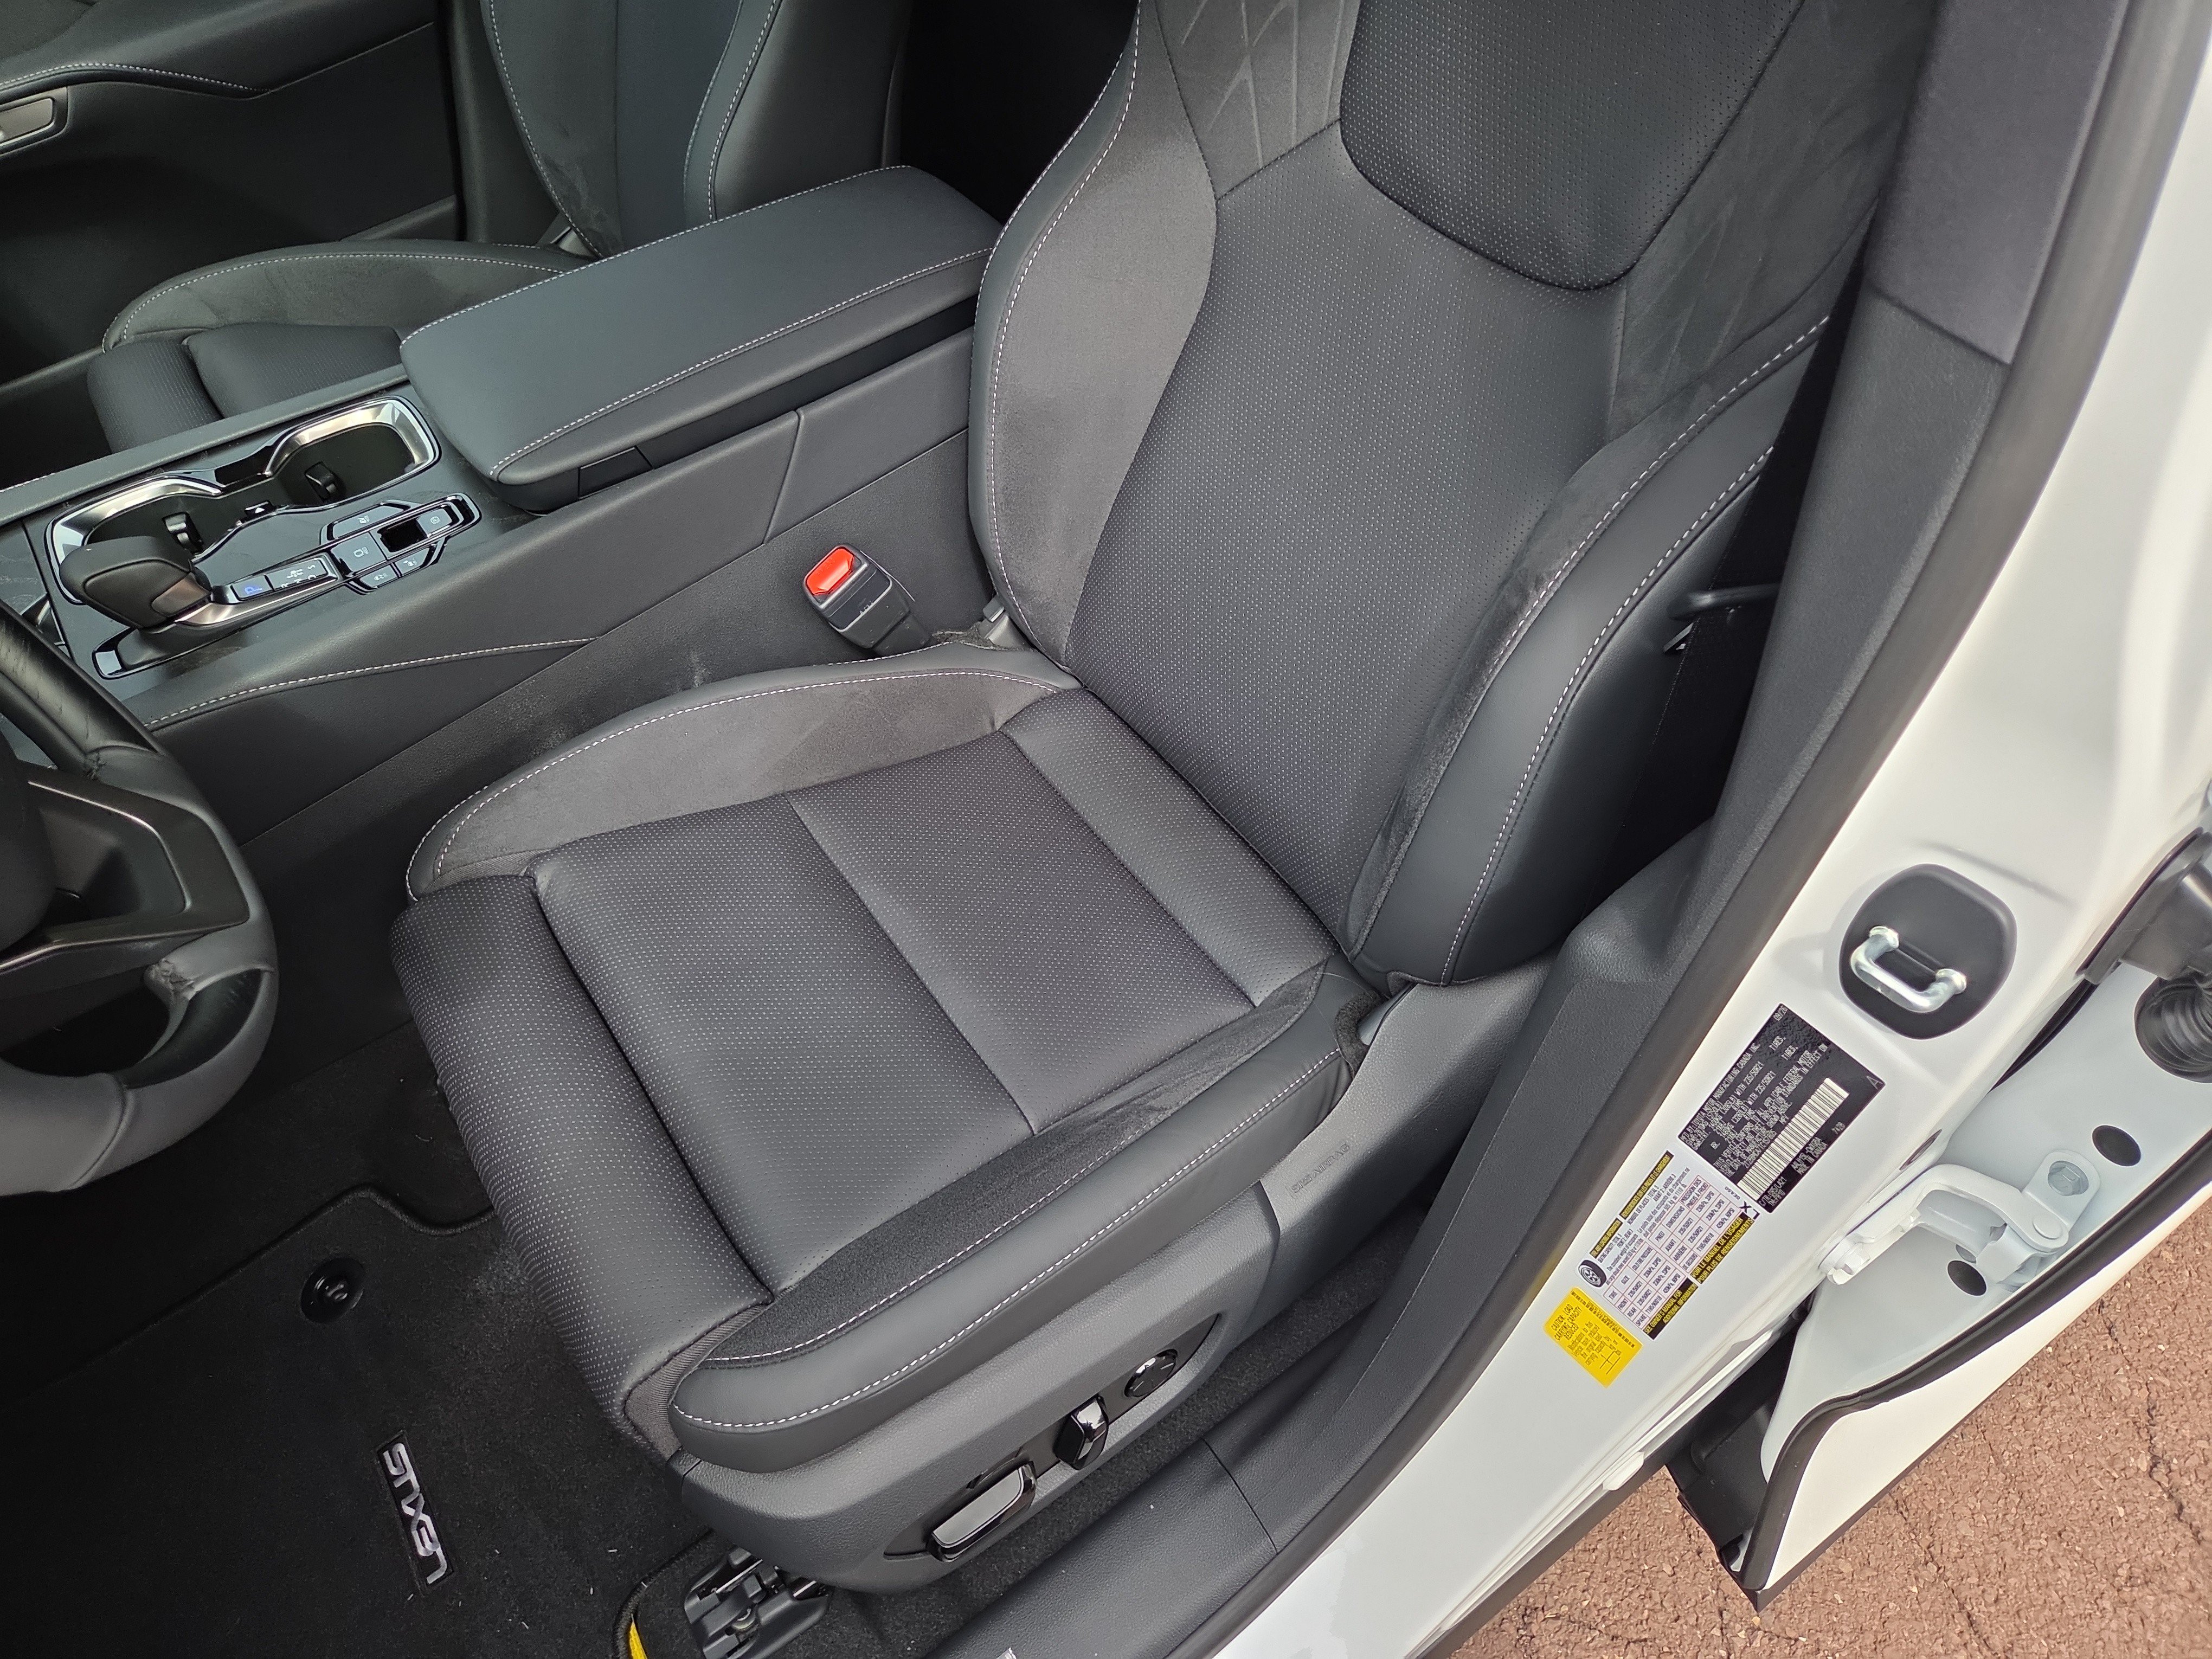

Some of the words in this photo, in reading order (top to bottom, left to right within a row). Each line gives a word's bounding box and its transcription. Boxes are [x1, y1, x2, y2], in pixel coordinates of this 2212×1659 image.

[1773, 1005, 1789, 1021] 09/26
[1734, 1082, 1747, 1096] WITH
[1742, 1060, 1764, 1085] 235/50R21
[1769, 1033, 1786, 1051] TIRES.
[1702, 1097, 1716, 1113] MOTOR
[1712, 1066, 1740, 1100] MANUFACTURING
[1735, 1050, 1753, 1069] CANADA
[1745, 1091, 1758, 1105] WITH
[1754, 1070, 1776, 1095] 235/50R21
[1863, 1072, 1883, 1090] A
[1713, 1156, 1725, 1169] THIS
[1721, 1140, 1738, 1159] VEHICLE
[1734, 1121, 1754, 1142] CONFORMS
[1751, 1114, 1759, 1122] TO
[1755, 1106, 1766, 1117] ALL
[1762, 1081, 1786, 1108] APPLICABLE
[1782, 1064, 1801, 1084] FEDERAL
[1796, 1050, 1812, 1066] MOTOR
[1718, 1155, 1735, 1174] VEHICLE
[1732, 1140, 1748, 1158] SAFETY
[1744, 1131, 1754, 1142] AND
[1751, 1119, 1765, 1134] THEFT
[1761, 1095, 1785, 1122] PREVENTION
[1780, 1072, 1803, 1097] STANDARDS
[1799, 1065, 1809, 1075] IN
[1804, 1050, 1822, 1069] EFFECT
[1817, 1042, 1828, 1053] ON
[1778, 1113, 1790, 1125] MPV
[1724, 1167, 1735, 1178] THE
[1731, 1158, 1743, 1171] DATE
[1739, 1152, 1748, 1160] OF
[1744, 1126, 1769, 1154] MANUFACTURE
[1765, 1113, 1780, 1128] SHOWN
[1291, 1175, 1313, 1193] SRS
[1312, 1143, 1350, 1179] AIRBAG
[1795, 1161, 1810, 1175] MADE
[1810, 1140, 1829, 1159] CANADA
[1680, 1185, 1696, 1204] PRESSION
[1693, 1178, 1702, 1187] DES
[1686, 1195, 1698, 1208] PNEUS
[1697, 1181, 1709, 1194] FROID
[1666, 1205, 1685, 1228] DIMENSIONS
[1739, 1200, 1760, 1220] LX
[1654, 1230, 1665, 1242] PNEU
[1722, 1216, 1744, 1239] L'USAGER
[1664, 1238, 1676, 1251] AVANT
[1696, 1270, 1709, 1283] POUR
[1706, 1259, 1718, 1272] PLUS
[1714, 1253, 1724, 1261] DE
[1720, 1217, 1754, 1255] RENSEIGNEMENTS
[1718, 1237, 1727, 1245] DE
[1671, 1244, 1687, 1262] ARRIÈRE
[1703, 1243, 1721, 1263] MANUEL
[1620, 1275, 1630, 1284] SIZE
[1690, 1266, 1702, 1278] VOIR
[1608, 1290, 1617, 1300] TIRE
[1617, 1298, 1629, 1310] FRONT
[1662, 1303, 1680, 1323] ADDITIONAL
[1676, 1283, 1697, 1306] INFORMATION
[1562, 1303, 1574, 1316] LOAD
[1626, 1307, 1637, 1317] REAR
[1635, 1314, 1647, 1326] SPARE
[1644, 1325, 1652, 1334] SEE
[1649, 1310, 1665, 1328] OWNER'S
[1662, 1296, 1676, 1313] MANUAL
[1673, 1289, 1683, 1299] FOR
[1553, 1321, 1571, 1341] CARRYING
[1565, 1305, 1583, 1324] CAPACITY
[1563, 1322, 1579, 1340] REDUCED
[383, 1443, 447, 1584] LEXUS
